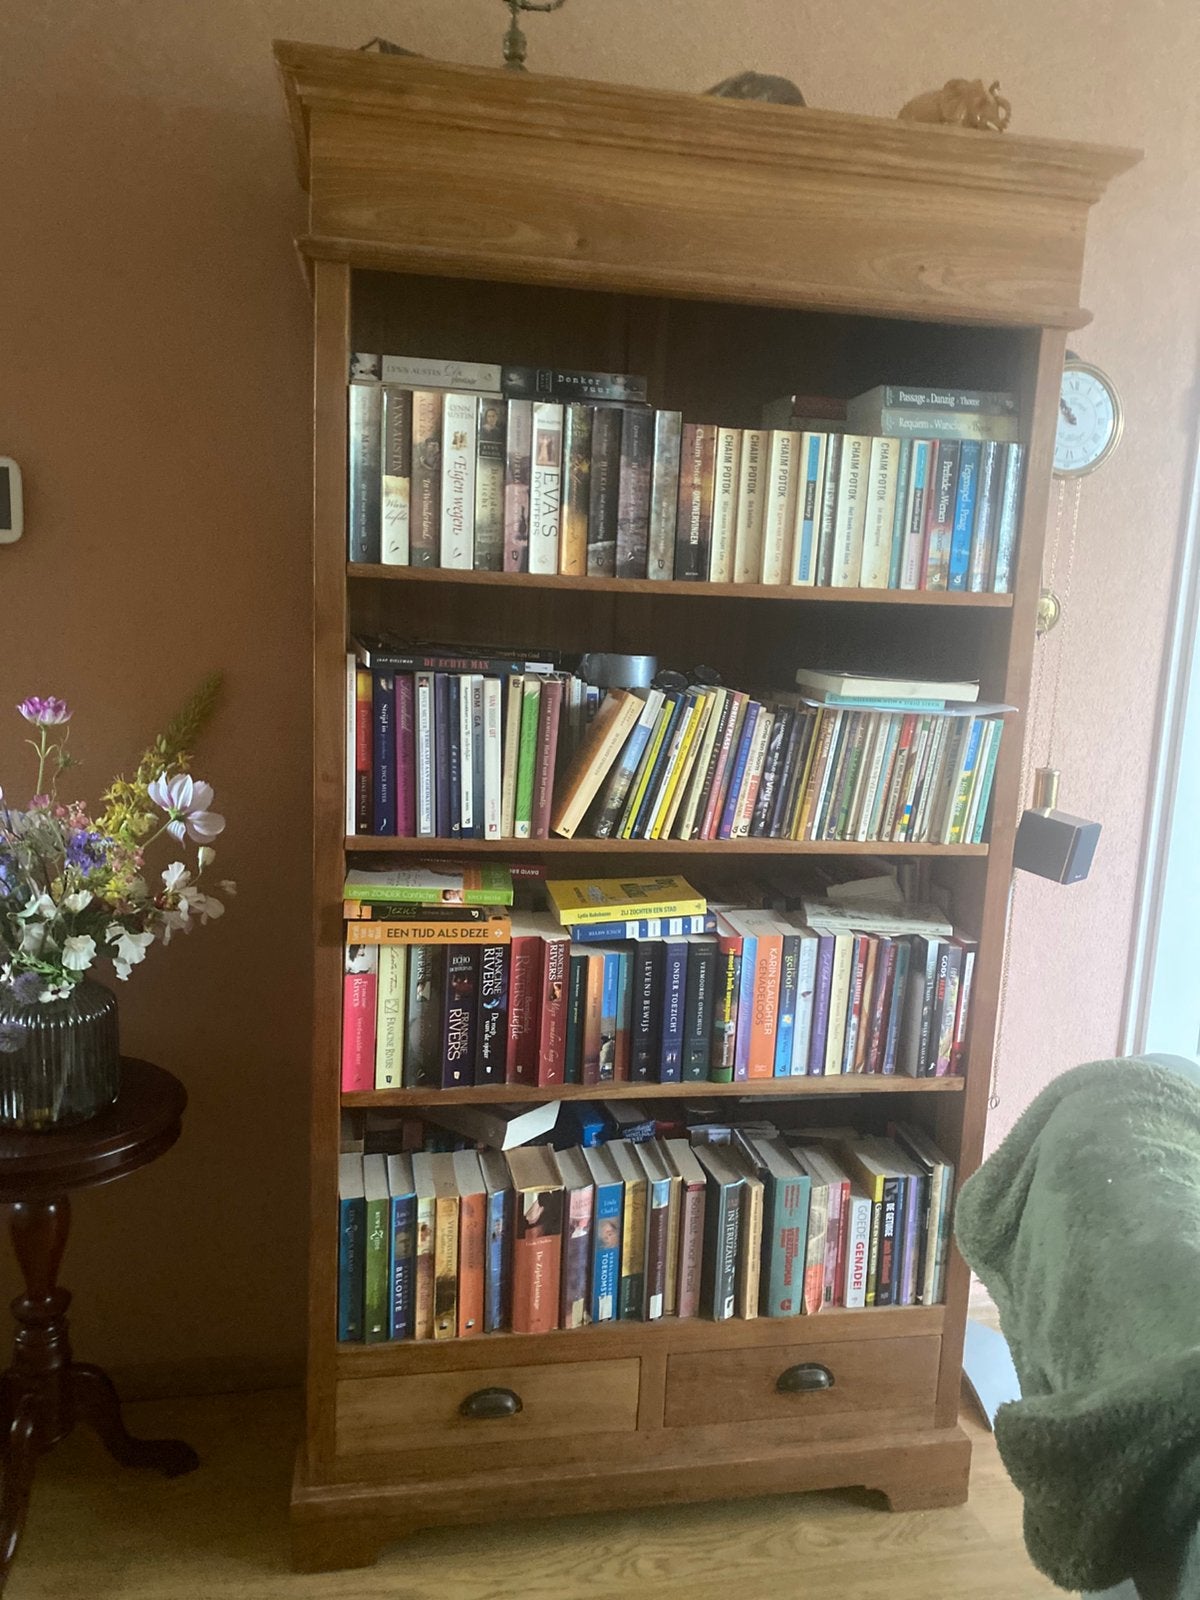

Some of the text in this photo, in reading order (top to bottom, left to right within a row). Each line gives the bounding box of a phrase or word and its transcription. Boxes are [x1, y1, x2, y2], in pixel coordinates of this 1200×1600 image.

[558, 374, 600, 386] Donker
[584, 386, 610, 395] vuur
[900, 391, 955, 406] Passage Danzig
[391, 397, 403, 471] LYNN AUSTIN
[693, 428, 704, 458] Chaim
[750, 434, 760, 463] CHAIM
[722, 434, 734, 496] CHAIM POTOK
[778, 438, 790, 498] CHAIM POTOK
[852, 441, 862, 469] CHAIM
[880, 442, 890, 470] CHAIM
[445, 456, 468, 536] Eigen wegen
[747, 465, 759, 495] POTOK
[848, 471, 859, 500] POTOK
[877, 473, 887, 501] POTOK
[938, 461, 952, 522] Prelude Wenen
[532, 472, 541, 536] DOCHTERS
[541, 472, 560, 538] EVA'S
[689, 490, 702, 546] OMZWERVINGEN
[958, 509, 970, 531] Praag
[424, 658, 434, 667] DE
[438, 658, 465, 669] ECHTE
[470, 659, 488, 670] MAN
[380, 704, 389, 724] Strijd
[381, 725, 388, 733] in
[474, 715, 481, 728] GA
[723, 700, 740, 750] ADRIAN PLASS
[754, 719, 772, 771] Corrie ten Boom
[763, 781, 775, 800] VRIJ
[520, 869, 540, 877] DAVID
[349, 889, 370, 898] Leven
[371, 889, 401, 898] ZONDER
[402, 890, 437, 900] Conflicten
[381, 905, 417, 918] Jezus
[621, 908, 629, 917] ZIJ
[630, 907, 652, 916] ZOCHTEN
[653, 906, 663, 914] EEN
[664, 905, 677, 913] STAD
[387, 926, 488, 939] EEN TIJD ALS DEZE
[482, 948, 496, 996] RIVERS
[493, 947, 503, 994] FRANCINE
[548, 944, 558, 980] RIVERS
[557, 943, 565, 980] FRANCINE
[784, 955, 797, 989] geloof
[938, 955, 949, 1001] GODS HART
[353, 978, 363, 1008] Rivers
[515, 955, 531, 1006] RIVERS
[640, 961, 653, 1033] LEVEND BEWIJS
[669, 962, 681, 1033] ONDER TOEZICHT
[755, 958, 768, 1026] GENADELOOS
[764, 948, 779, 1035] KARIN SLAUGHTER
[926, 981, 934, 1002] Thuis
[696, 961, 706, 1036] VERMOORDE ONSCHULD
[447, 1008, 462, 1061] RIVERS
[460, 1012, 469, 1054] FRANCINE
[484, 1033, 491, 1041] de
[489, 1013, 499, 1036] De roep
[510, 1007, 526, 1040] Liefde
[385, 1017, 396, 1070] FRANCINE RIVERS
[884, 1202, 895, 1237] DE GETUIGE
[689, 1239, 697, 1260] voor
[724, 1209, 736, 1274] IN JERUZALEM
[852, 1204, 868, 1290] GOEDE GENADE!
[395, 1266, 403, 1312] BELOFTE
[599, 1253, 609, 1297] TOEKOMST
